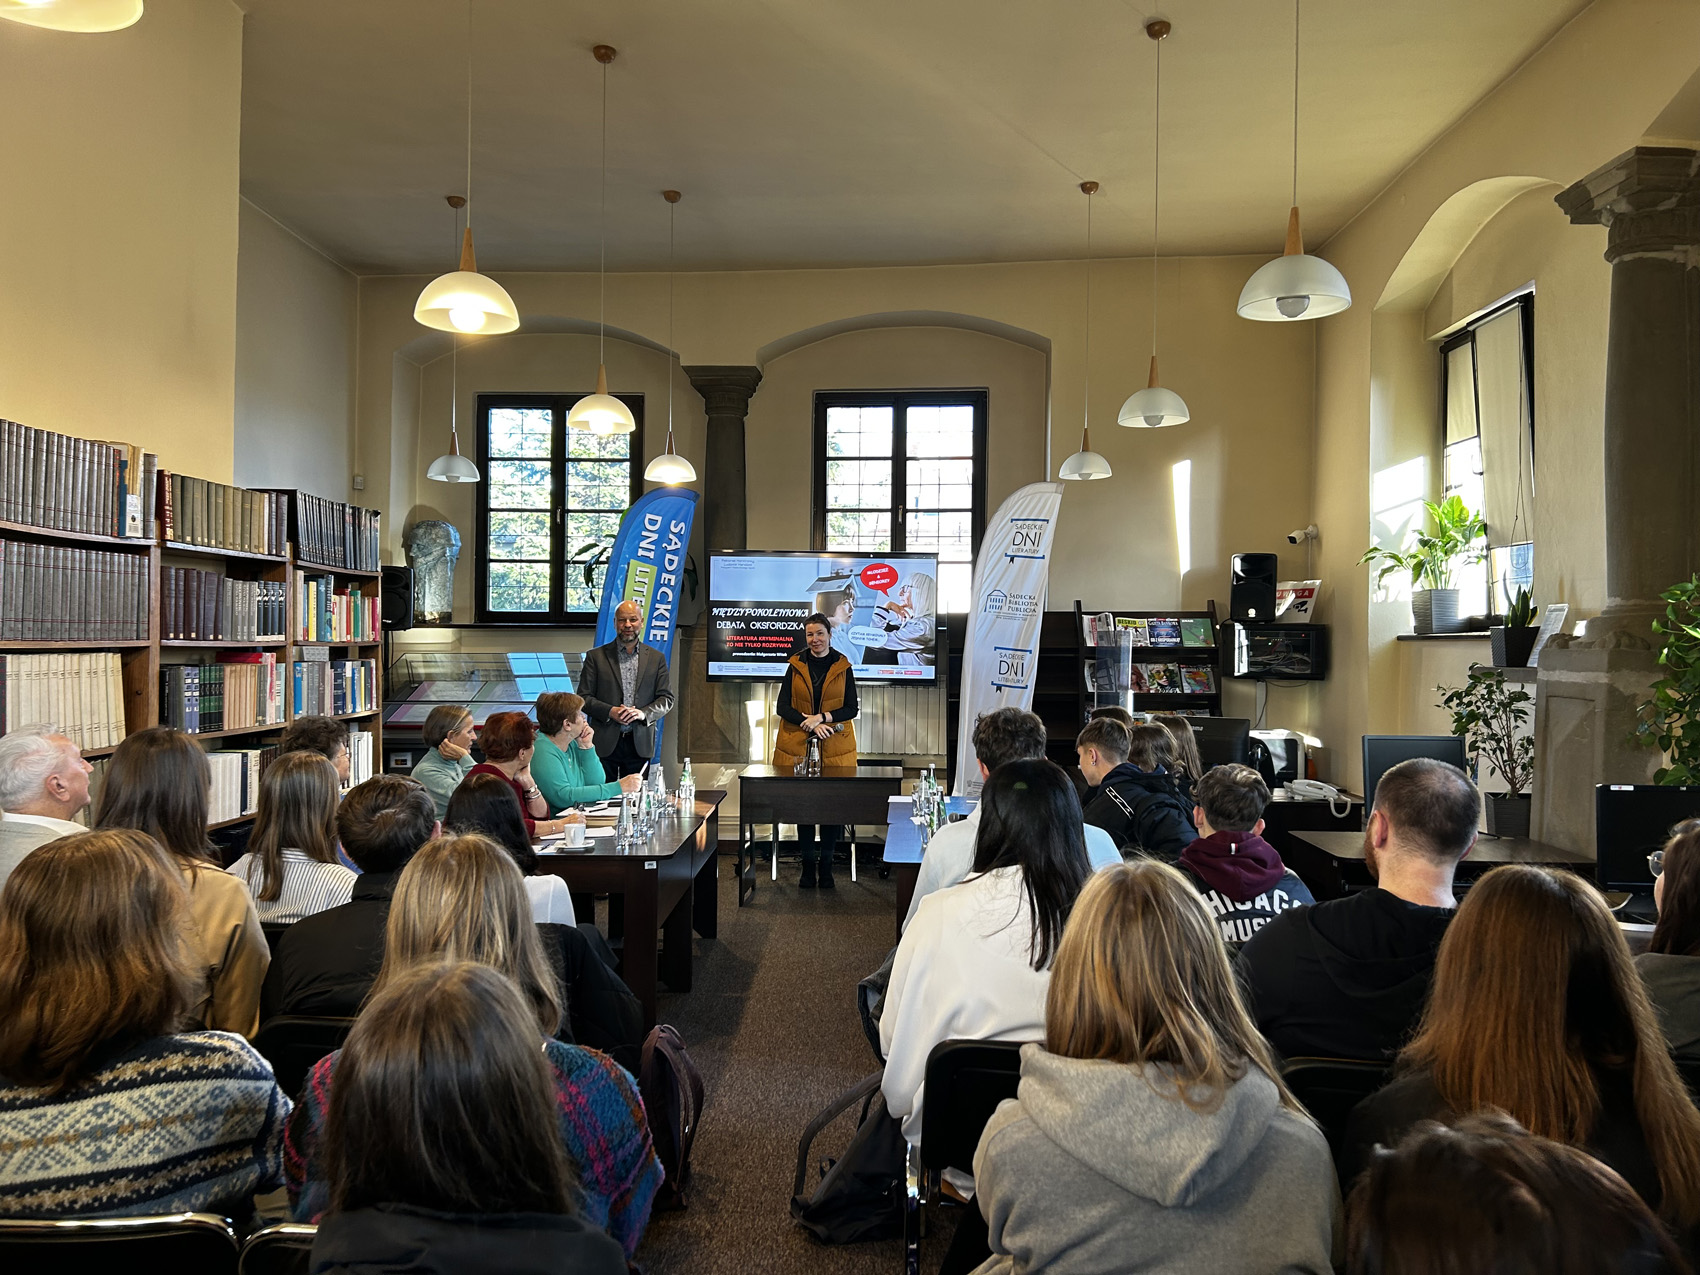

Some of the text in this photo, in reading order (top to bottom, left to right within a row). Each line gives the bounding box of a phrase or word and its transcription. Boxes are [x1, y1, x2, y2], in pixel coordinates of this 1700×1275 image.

[1012, 531, 1041, 547] DNI
[632, 513, 662, 616] DNI LITE
[648, 520, 685, 642] SĄDECKIE
[716, 621, 805, 630] DEBATA OKSFORDZKA
[998, 660, 1024, 677] DNI
[1220, 917, 1272, 942] MUS
